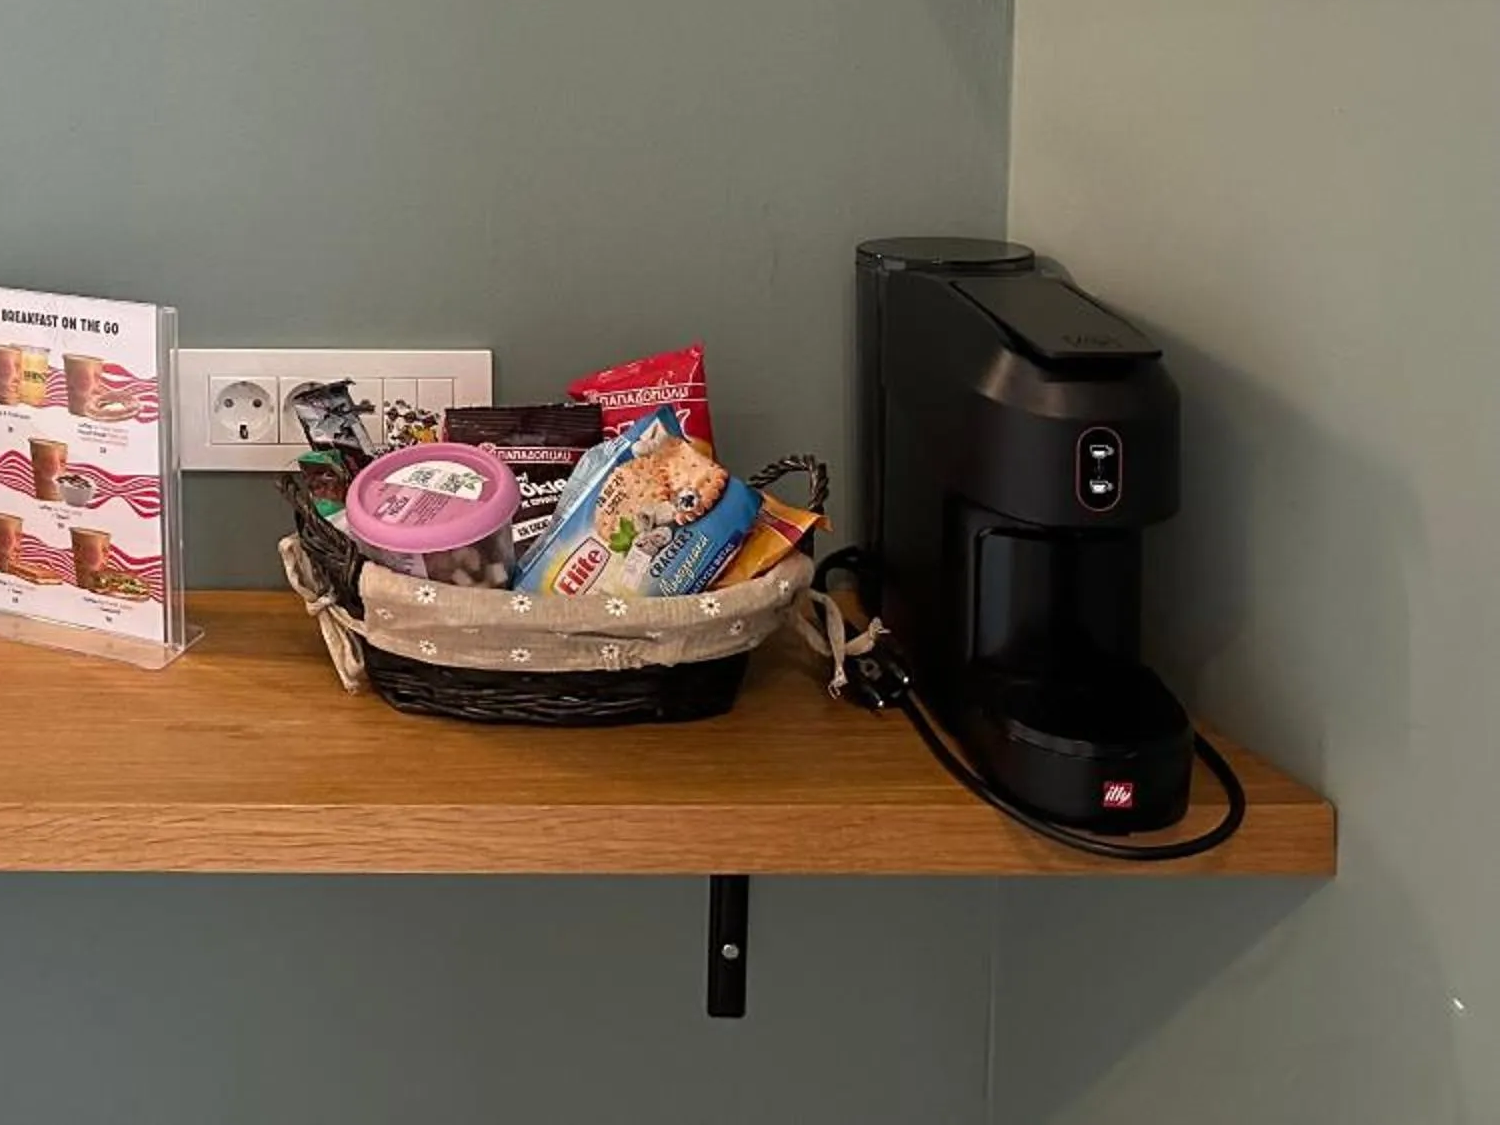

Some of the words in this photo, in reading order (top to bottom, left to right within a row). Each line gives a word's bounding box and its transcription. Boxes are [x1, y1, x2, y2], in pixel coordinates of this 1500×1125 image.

[1, 308, 59, 328] BREAKFAST
[61, 316, 77, 330] ON
[80, 318, 101, 333] THE
[103, 321, 119, 335] GO
[558, 547, 602, 597] Elite
[649, 529, 694, 578] CRACKERS
[1105, 786, 1131, 805] illy
